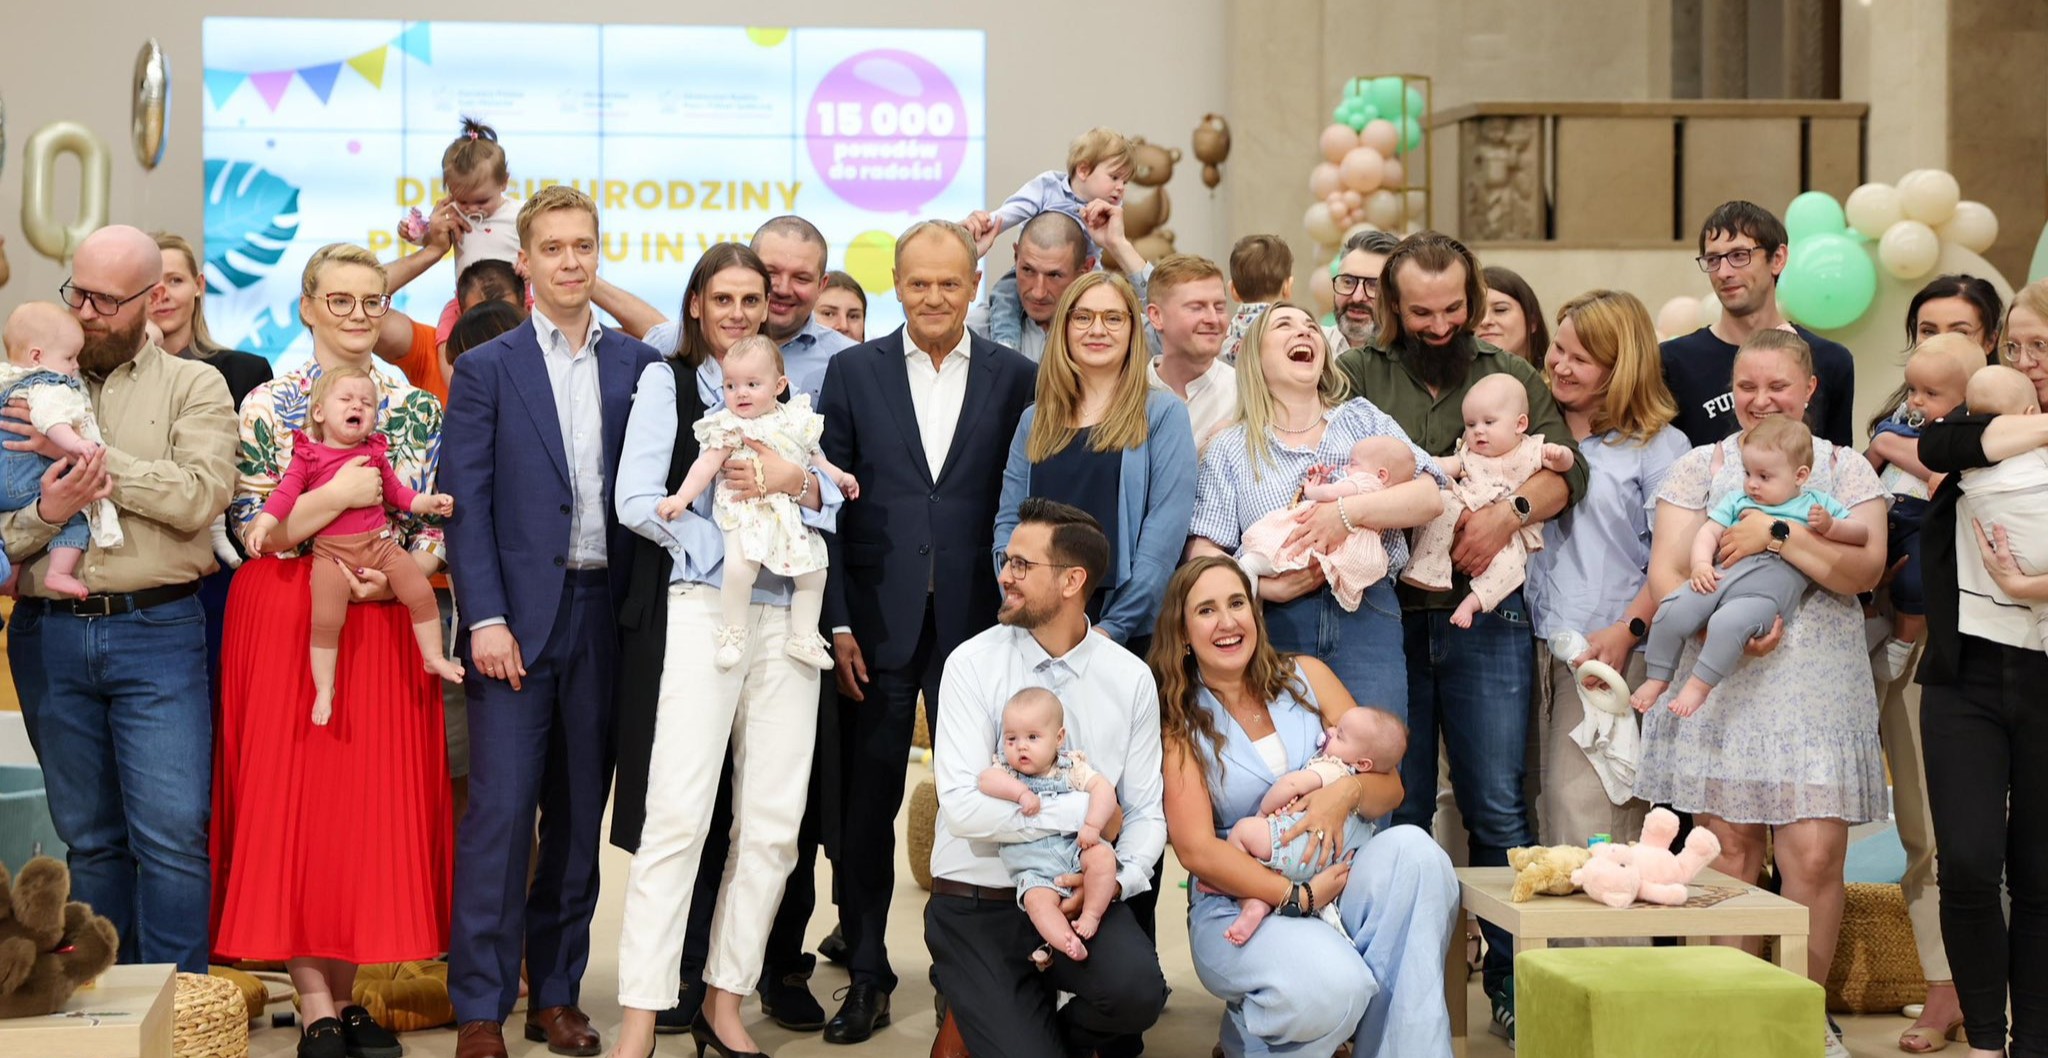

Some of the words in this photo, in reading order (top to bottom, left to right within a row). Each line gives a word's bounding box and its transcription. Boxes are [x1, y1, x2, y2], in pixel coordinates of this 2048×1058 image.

[816, 101, 863, 137] 15
[870, 101, 955, 137] 000
[833, 140, 939, 163] powodów
[827, 162, 858, 181] do
[859, 160, 943, 181] radości
[642, 232, 685, 263] IN
